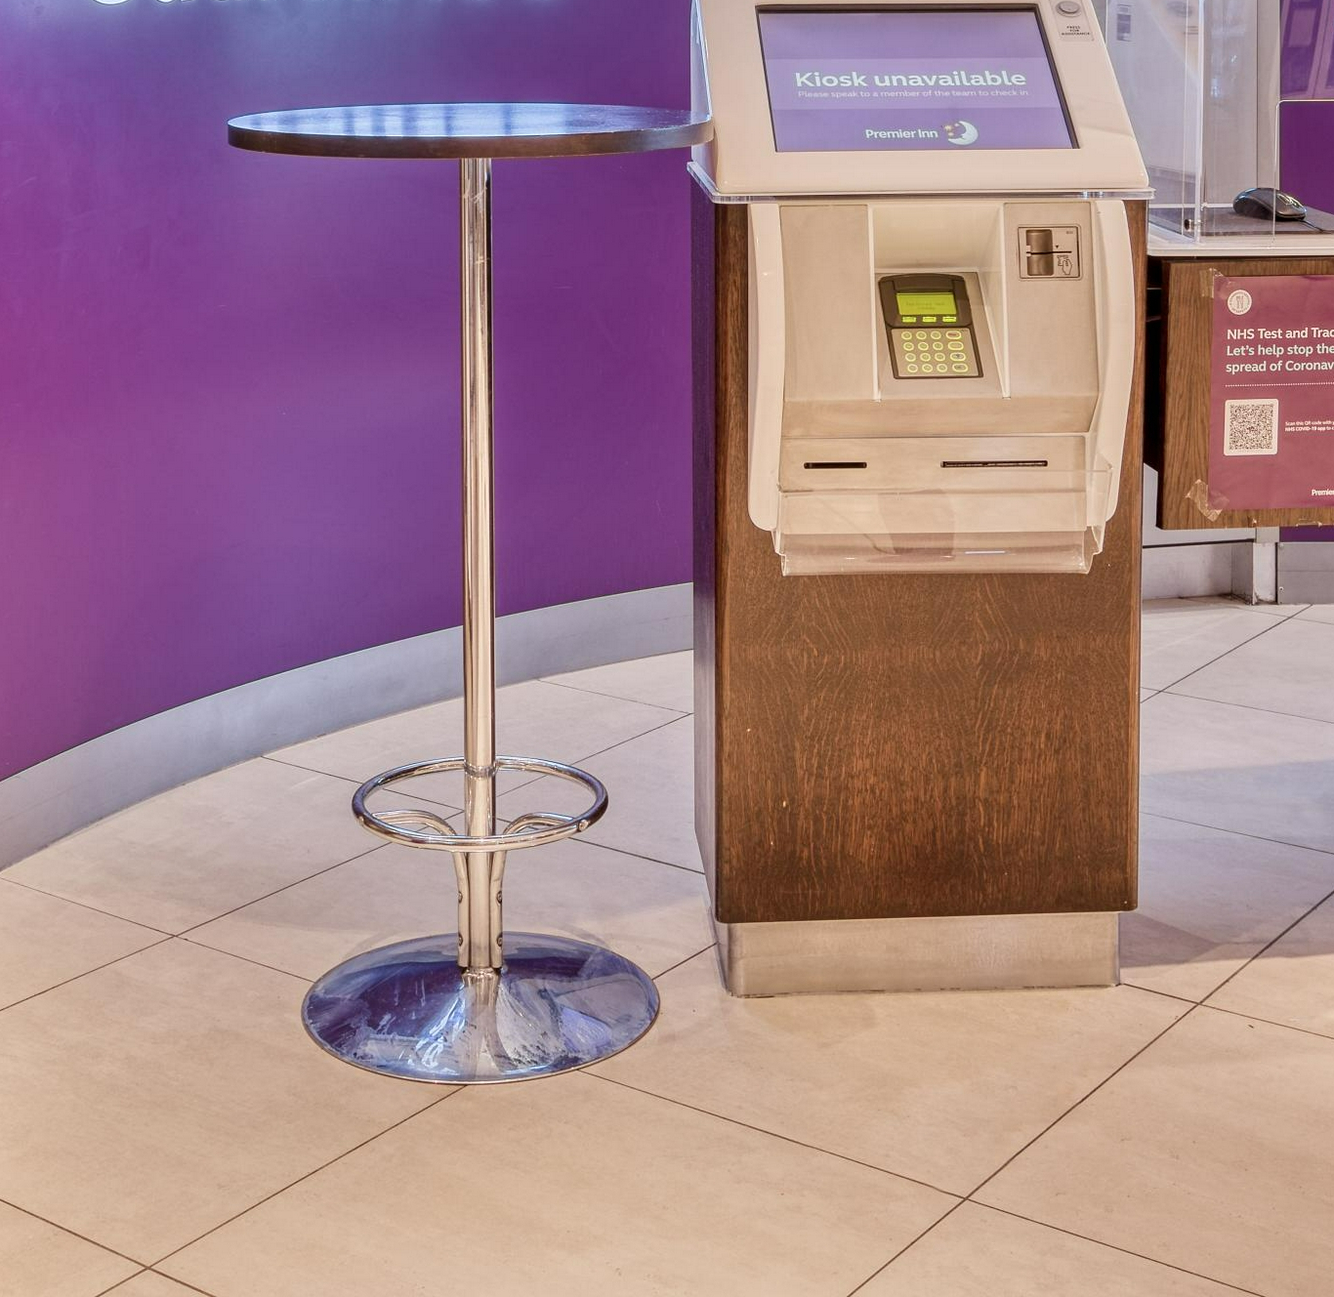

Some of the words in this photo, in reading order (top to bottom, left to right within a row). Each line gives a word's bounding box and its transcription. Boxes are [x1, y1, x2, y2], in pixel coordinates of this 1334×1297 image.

[795, 72, 867, 87] Kiosk
[873, 71, 1027, 86] unavailable
[798, 90, 829, 98] Please
[831, 90, 858, 98] speak
[865, 129, 916, 139] Premier
[918, 129, 938, 138] Inn
[1227, 328, 1255, 340] NHS
[1258, 328, 1282, 339] Test
[1285, 327, 1308, 339] and
[1226, 345, 1255, 356] Let's
[1257, 344, 1284, 357] help
[1287, 344, 1313, 356] stop
[1225, 360, 1266, 374] spread
[1269, 360, 1283, 372] of
